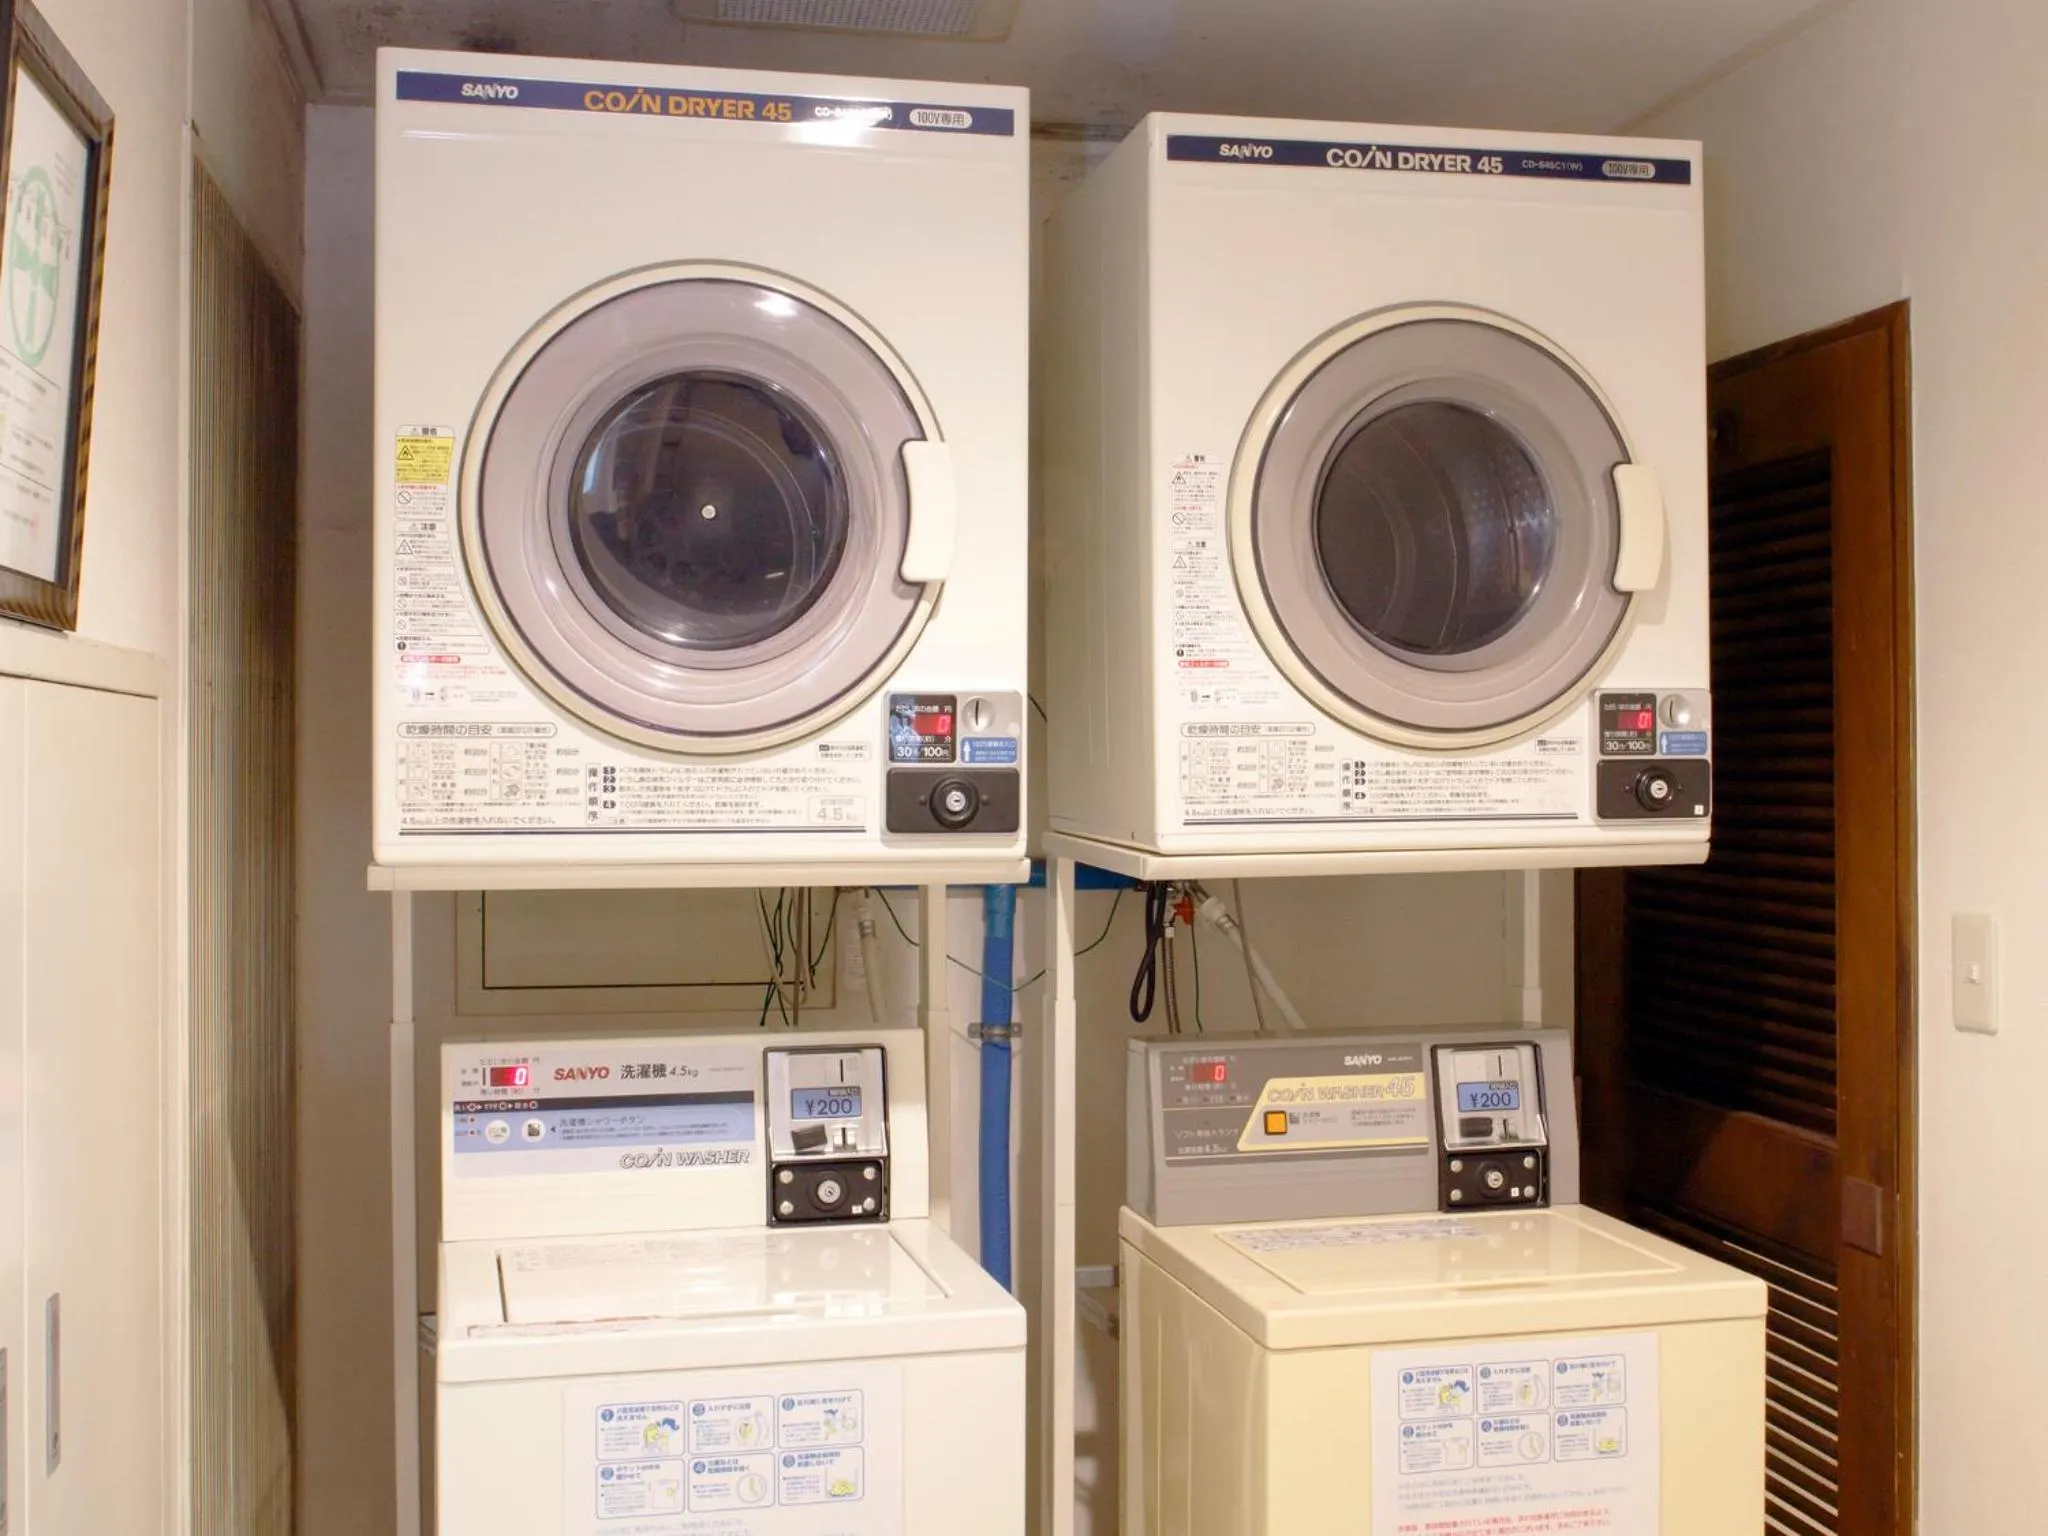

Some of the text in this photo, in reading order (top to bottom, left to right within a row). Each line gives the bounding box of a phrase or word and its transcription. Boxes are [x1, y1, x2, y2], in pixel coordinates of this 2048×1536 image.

[460, 83, 519, 100] SANYO
[583, 87, 661, 116] COIN
[669, 94, 754, 120] DRYER
[761, 101, 792, 122] 45
[916, 109, 965, 128] 100V専用
[1219, 143, 1273, 160] SANYO
[1326, 146, 1503, 174] COIN DRYER 45
[938, 715, 952, 733] 0
[1638, 712, 1652, 729] 0
[405, 724, 493, 736] 乾燥時間の目安
[1187, 724, 1261, 735] 乾燥時間の目安
[1344, 1054, 1382, 1067] SANYO
[515, 1067, 527, 1085] 0
[553, 1065, 610, 1081] SANYO
[620, 1062, 668, 1080] 洗濯機
[669, 1065, 699, 1078] 4.5kg
[1214, 1065, 1225, 1081] 0
[1268, 1076, 1416, 1103] COIN WASHER 45
[804, 1098, 853, 1116] ¥200
[1470, 1091, 1511, 1108] ¥200
[620, 1147, 750, 1168] COIN WASHER
